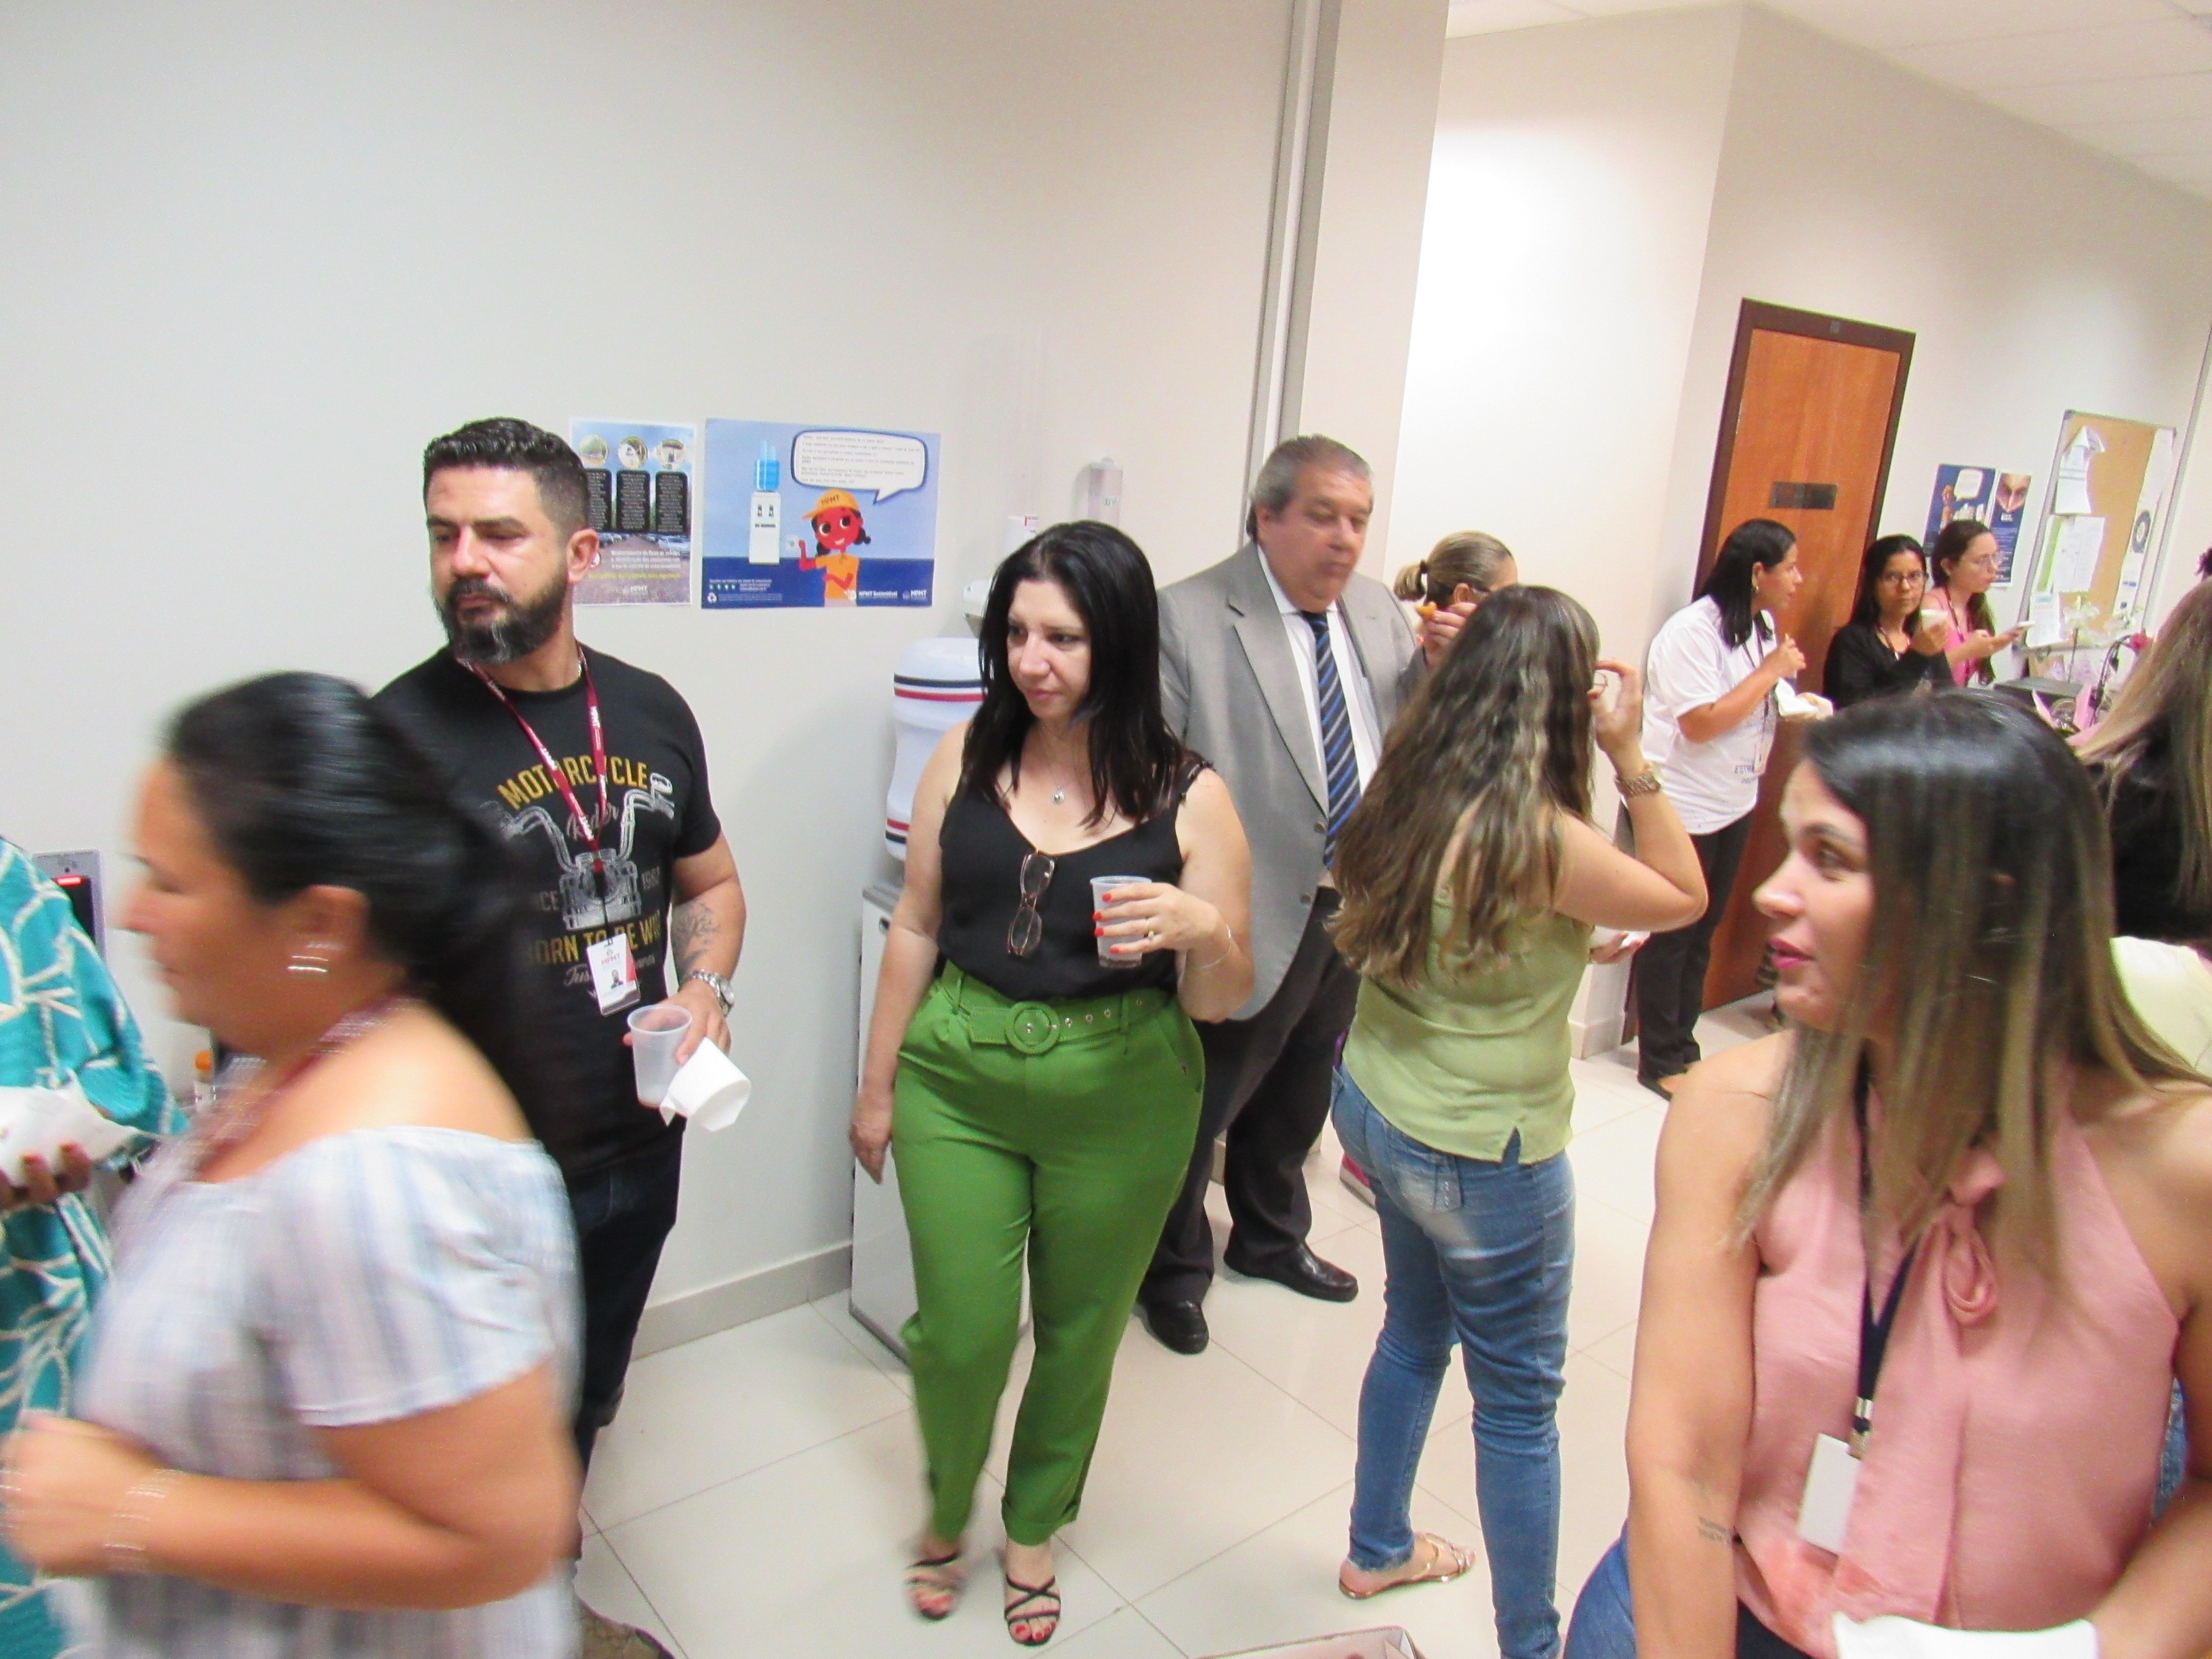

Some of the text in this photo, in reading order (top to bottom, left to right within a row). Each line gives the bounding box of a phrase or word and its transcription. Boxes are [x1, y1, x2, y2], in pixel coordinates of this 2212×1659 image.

[497, 754, 648, 811] MOTRCCLE
[533, 934, 579, 965] ORN
[601, 953, 621, 965] MPMT
